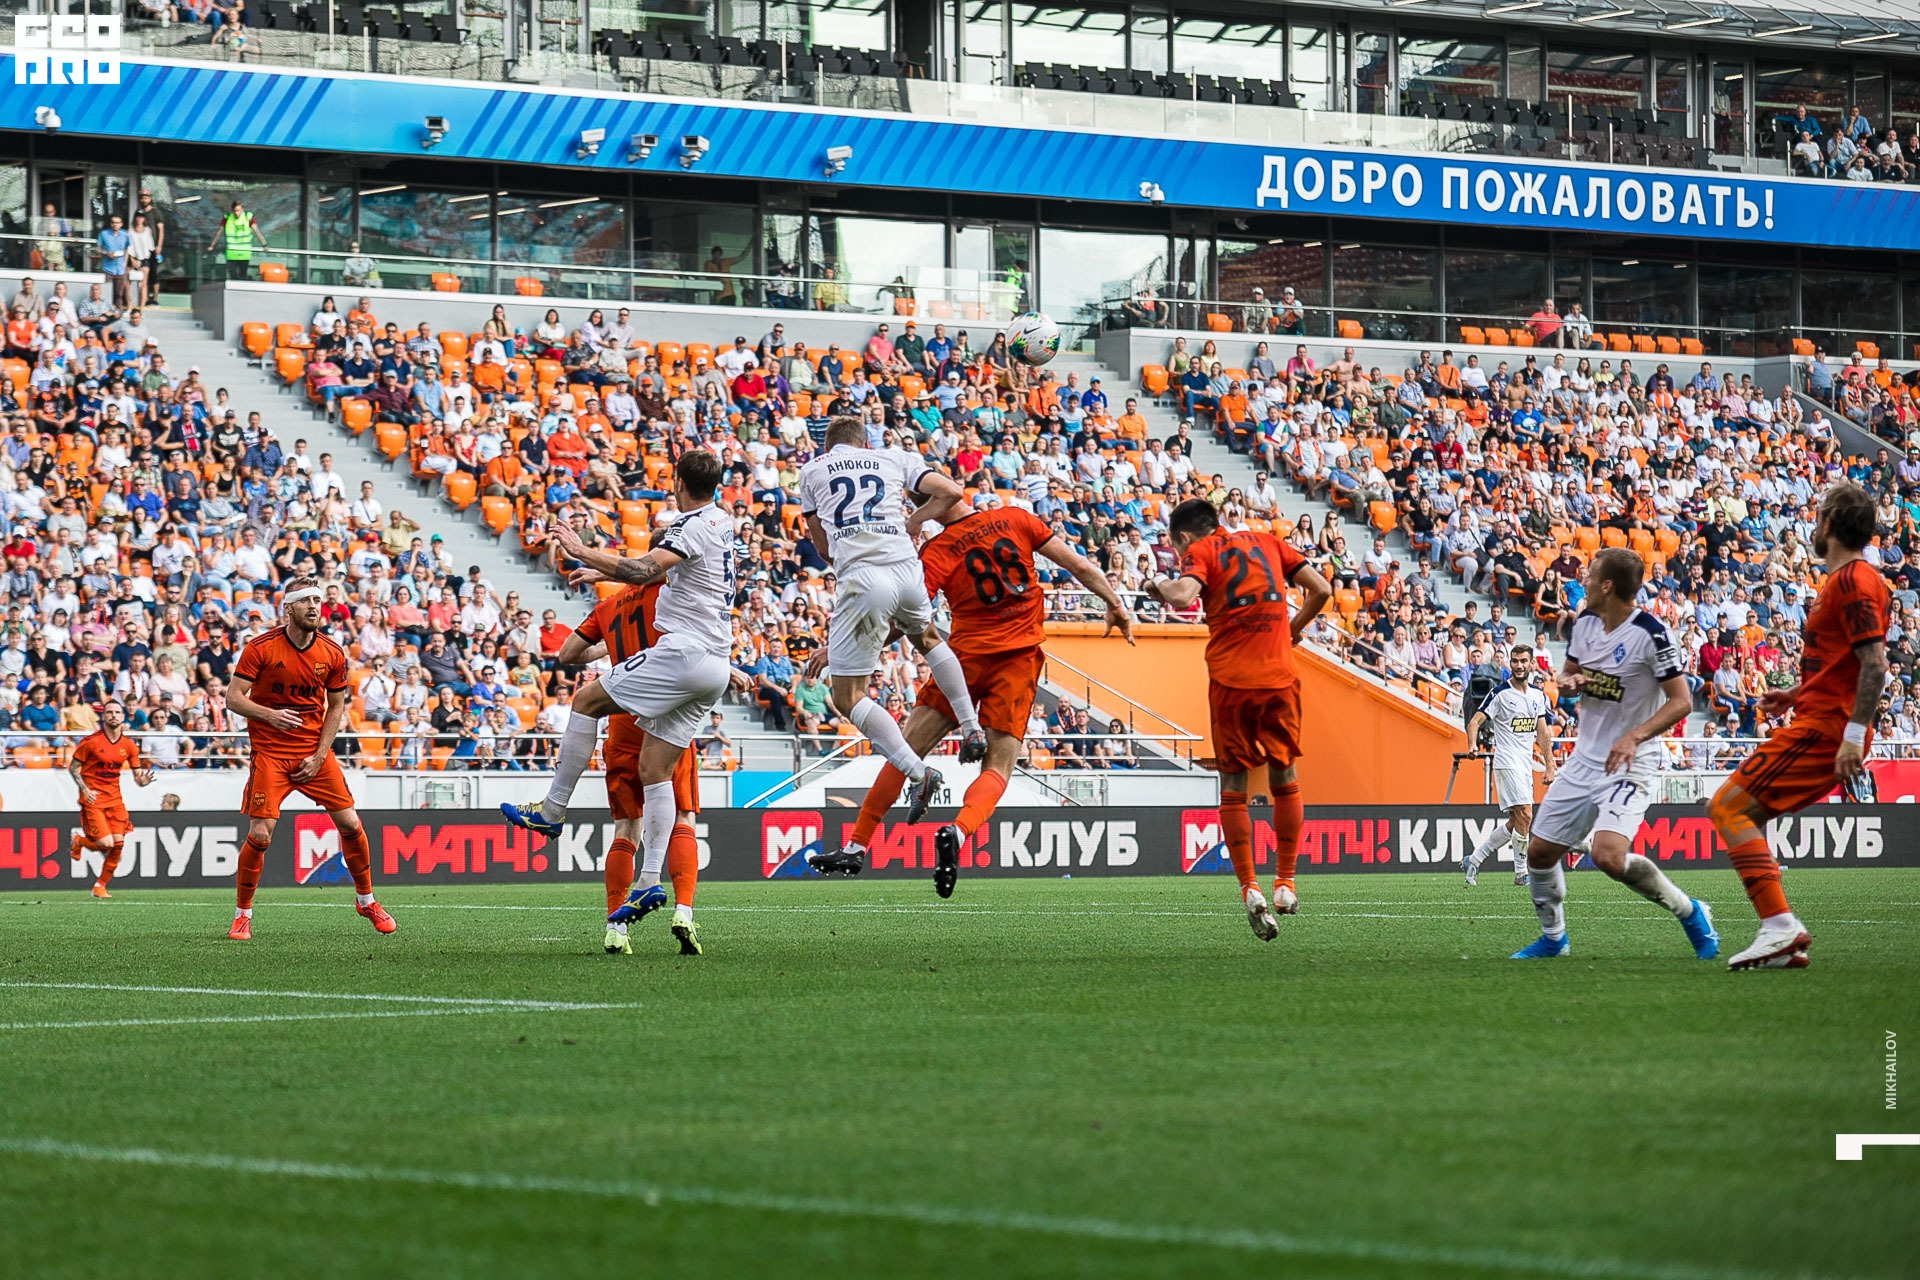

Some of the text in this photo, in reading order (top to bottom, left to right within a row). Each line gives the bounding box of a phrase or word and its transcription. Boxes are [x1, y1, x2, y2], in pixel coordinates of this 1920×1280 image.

[1257, 155, 1774, 230] ДОБРО ПОЖАЛОВАТЬ!
[827, 459, 880, 475] АНЮКОВ
[829, 474, 886, 529] 22
[948, 519, 1010, 557] ПОГРЕБНЯК
[964, 537, 1029, 606] 88
[1218, 546, 1282, 609] 21
[608, 605, 650, 665] 11
[1609, 780, 1637, 806] 77
[382, 824, 548, 875] МАТЧ!
[841, 822, 991, 869] МАТ!
[1000, 820, 1139, 867] КЛУБ
[1766, 816, 1884, 859] КЛУБ
